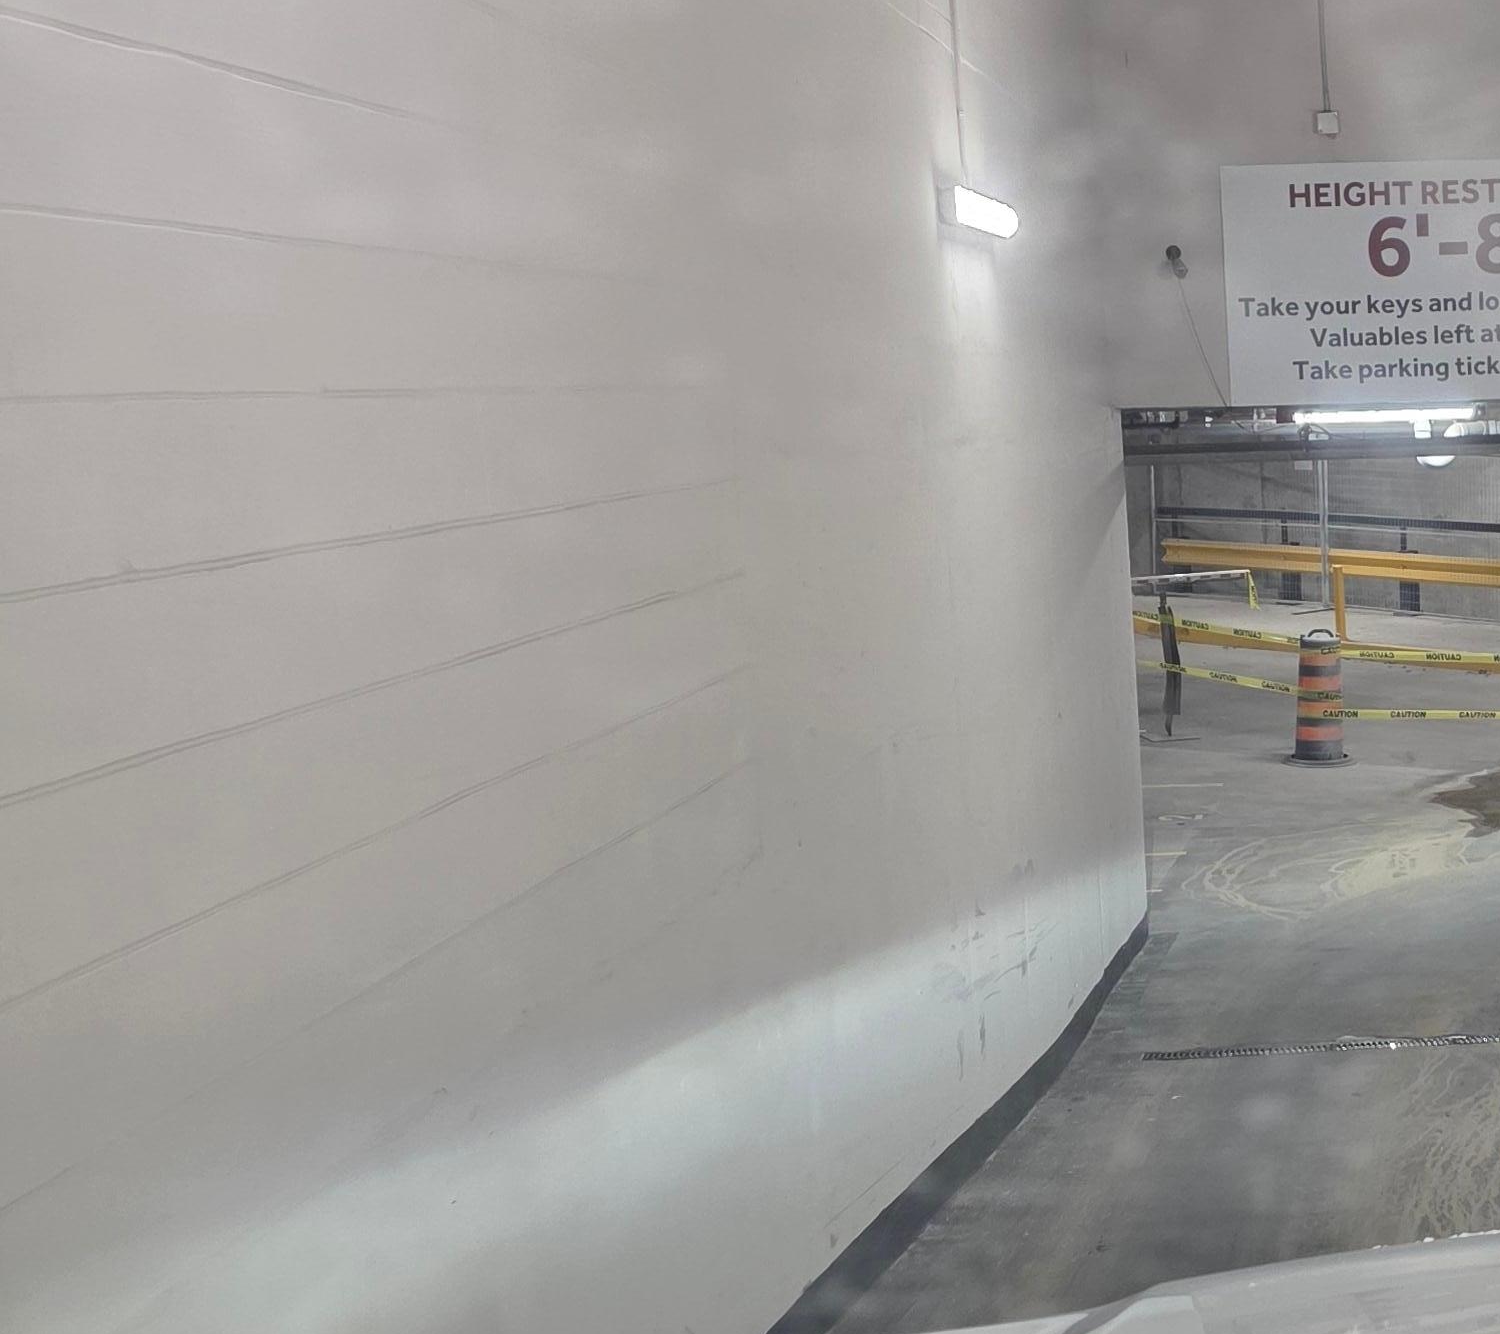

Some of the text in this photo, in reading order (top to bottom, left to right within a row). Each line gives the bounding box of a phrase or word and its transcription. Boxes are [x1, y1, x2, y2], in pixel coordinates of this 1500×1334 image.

[1289, 181, 1413, 208] HEIGHT
[1238, 297, 1299, 317] Take
[1305, 299, 1361, 321] your
[1366, 295, 1423, 318] keys
[1429, 291, 1472, 312] and
[1310, 326, 1427, 347] Valuables
[1434, 324, 1475, 344] left
[1293, 360, 1352, 380] Take
[1359, 358, 1449, 383] parking
[1209, 672, 1238, 683] CAUTION
[1261, 681, 1290, 693] CAUTION
[1323, 709, 1358, 718] CAUTION
[1390, 709, 1427, 718] CAUTION
